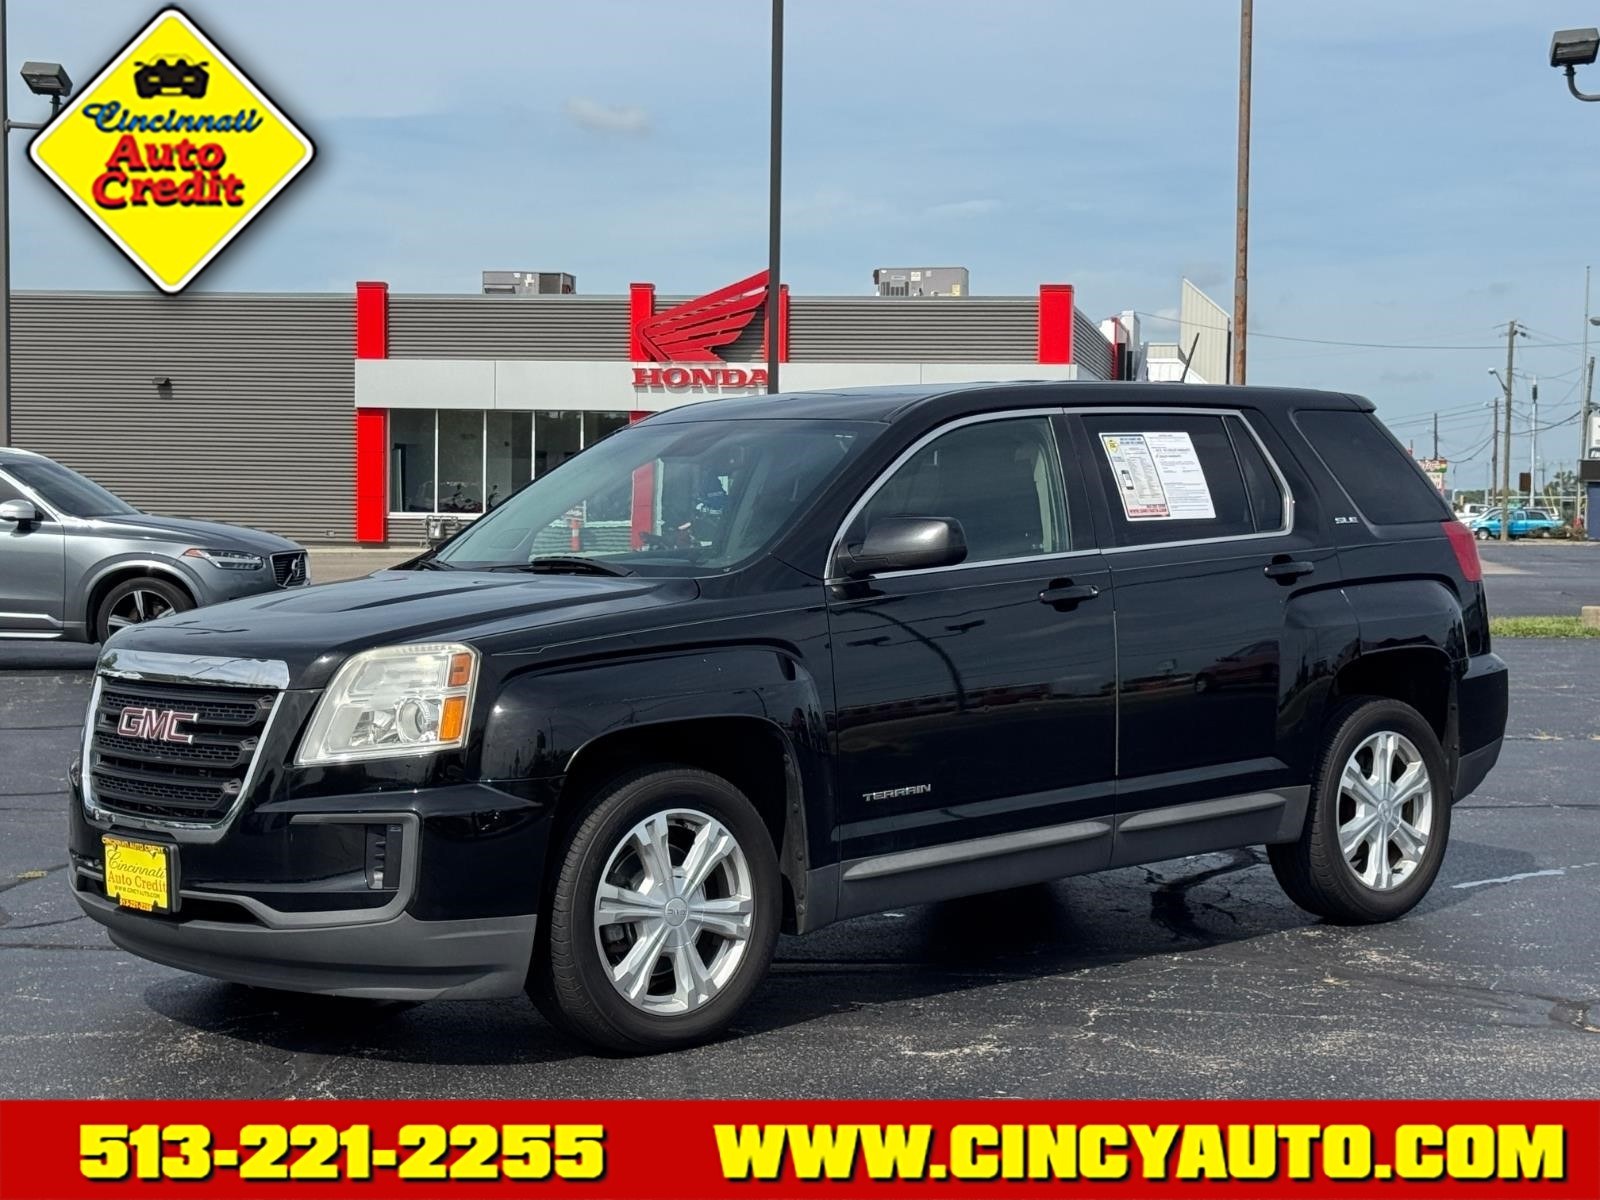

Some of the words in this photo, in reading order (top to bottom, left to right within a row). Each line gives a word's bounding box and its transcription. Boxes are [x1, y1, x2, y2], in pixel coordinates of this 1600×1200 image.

[632, 368, 769, 388] HONDA
[1334, 517, 1359, 525] SLE
[117, 706, 198, 743] GMC
[862, 784, 931, 801] TERRAIN
[107, 849, 165, 878] Cincinnati
[108, 871, 132, 886] Auto
